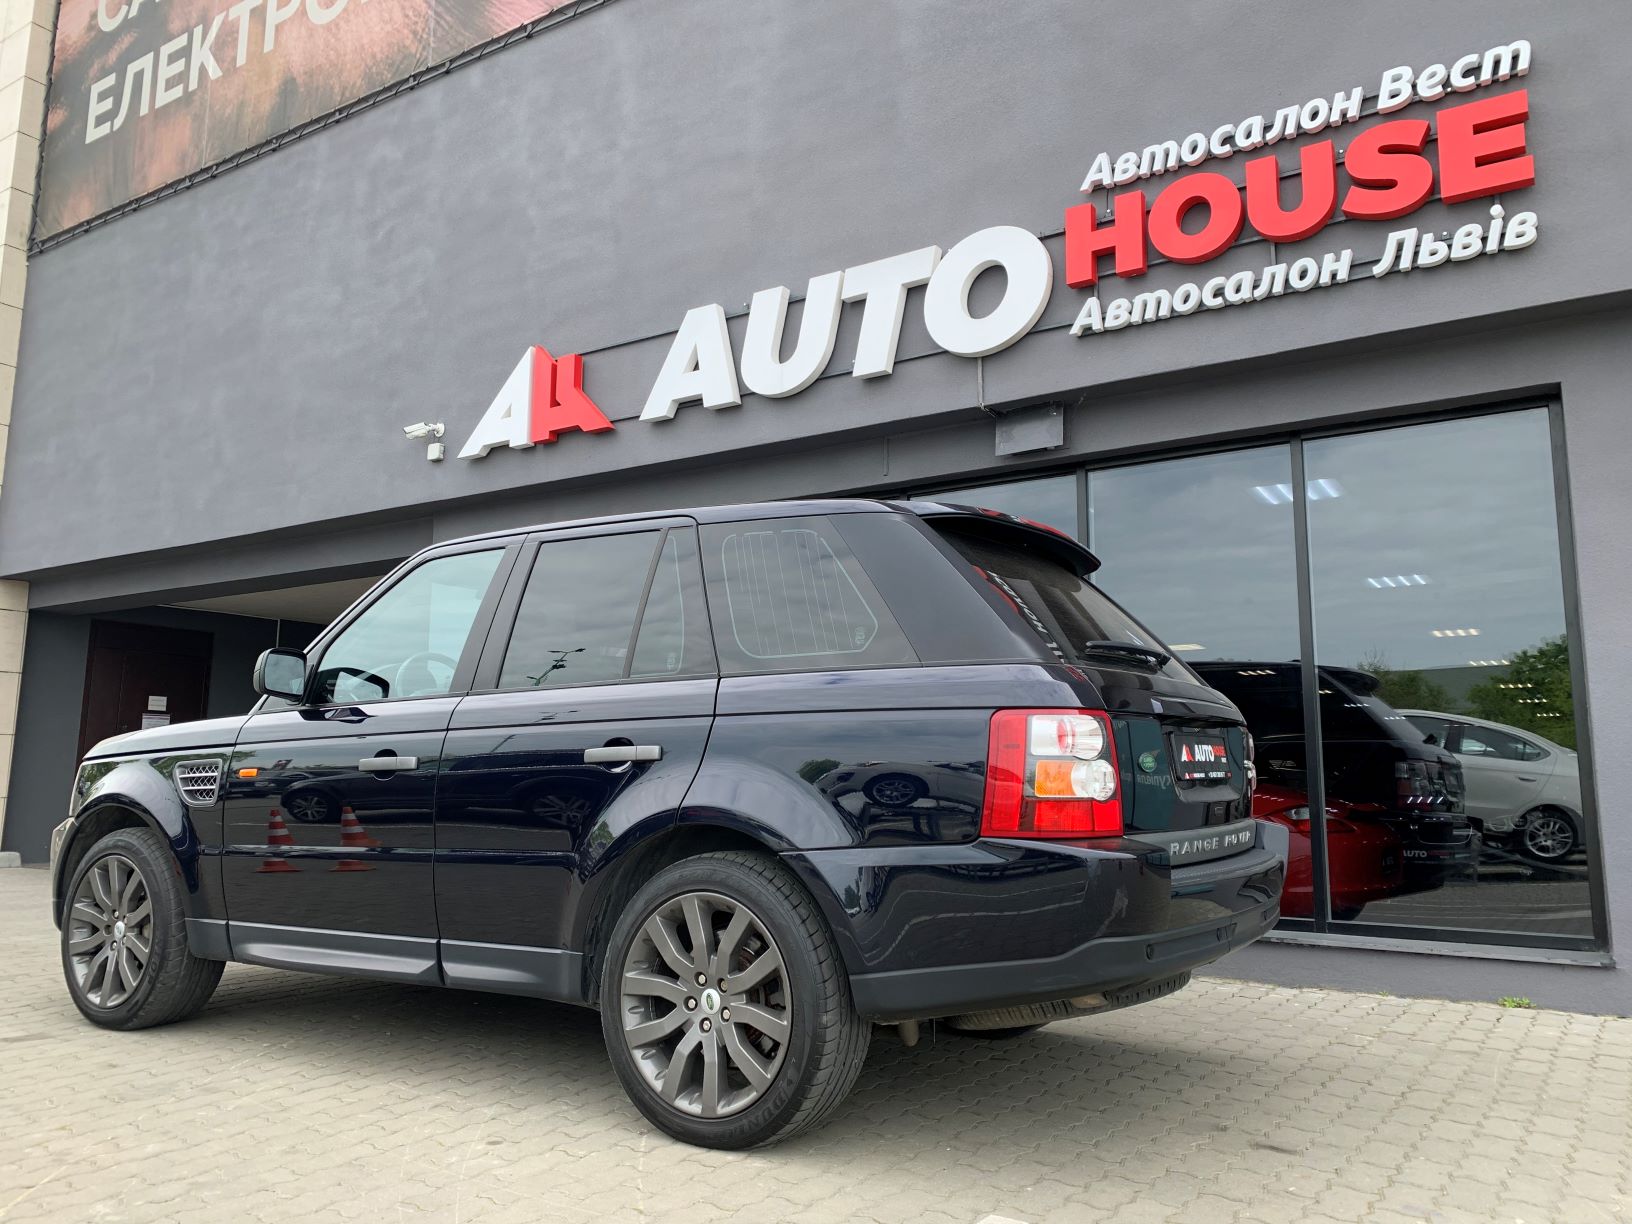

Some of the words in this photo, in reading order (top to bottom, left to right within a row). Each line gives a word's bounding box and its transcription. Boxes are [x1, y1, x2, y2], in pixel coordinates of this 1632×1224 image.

[1080, 87, 1364, 193] Автосалон
[1377, 39, 1532, 114] Вест
[639, 225, 1053, 422] AUTO
[1065, 89, 1535, 289] HOUSE
[1070, 249, 1353, 337] Автосалон
[1372, 204, 1539, 278] Львів
[1170, 837, 1219, 857] RANGE
